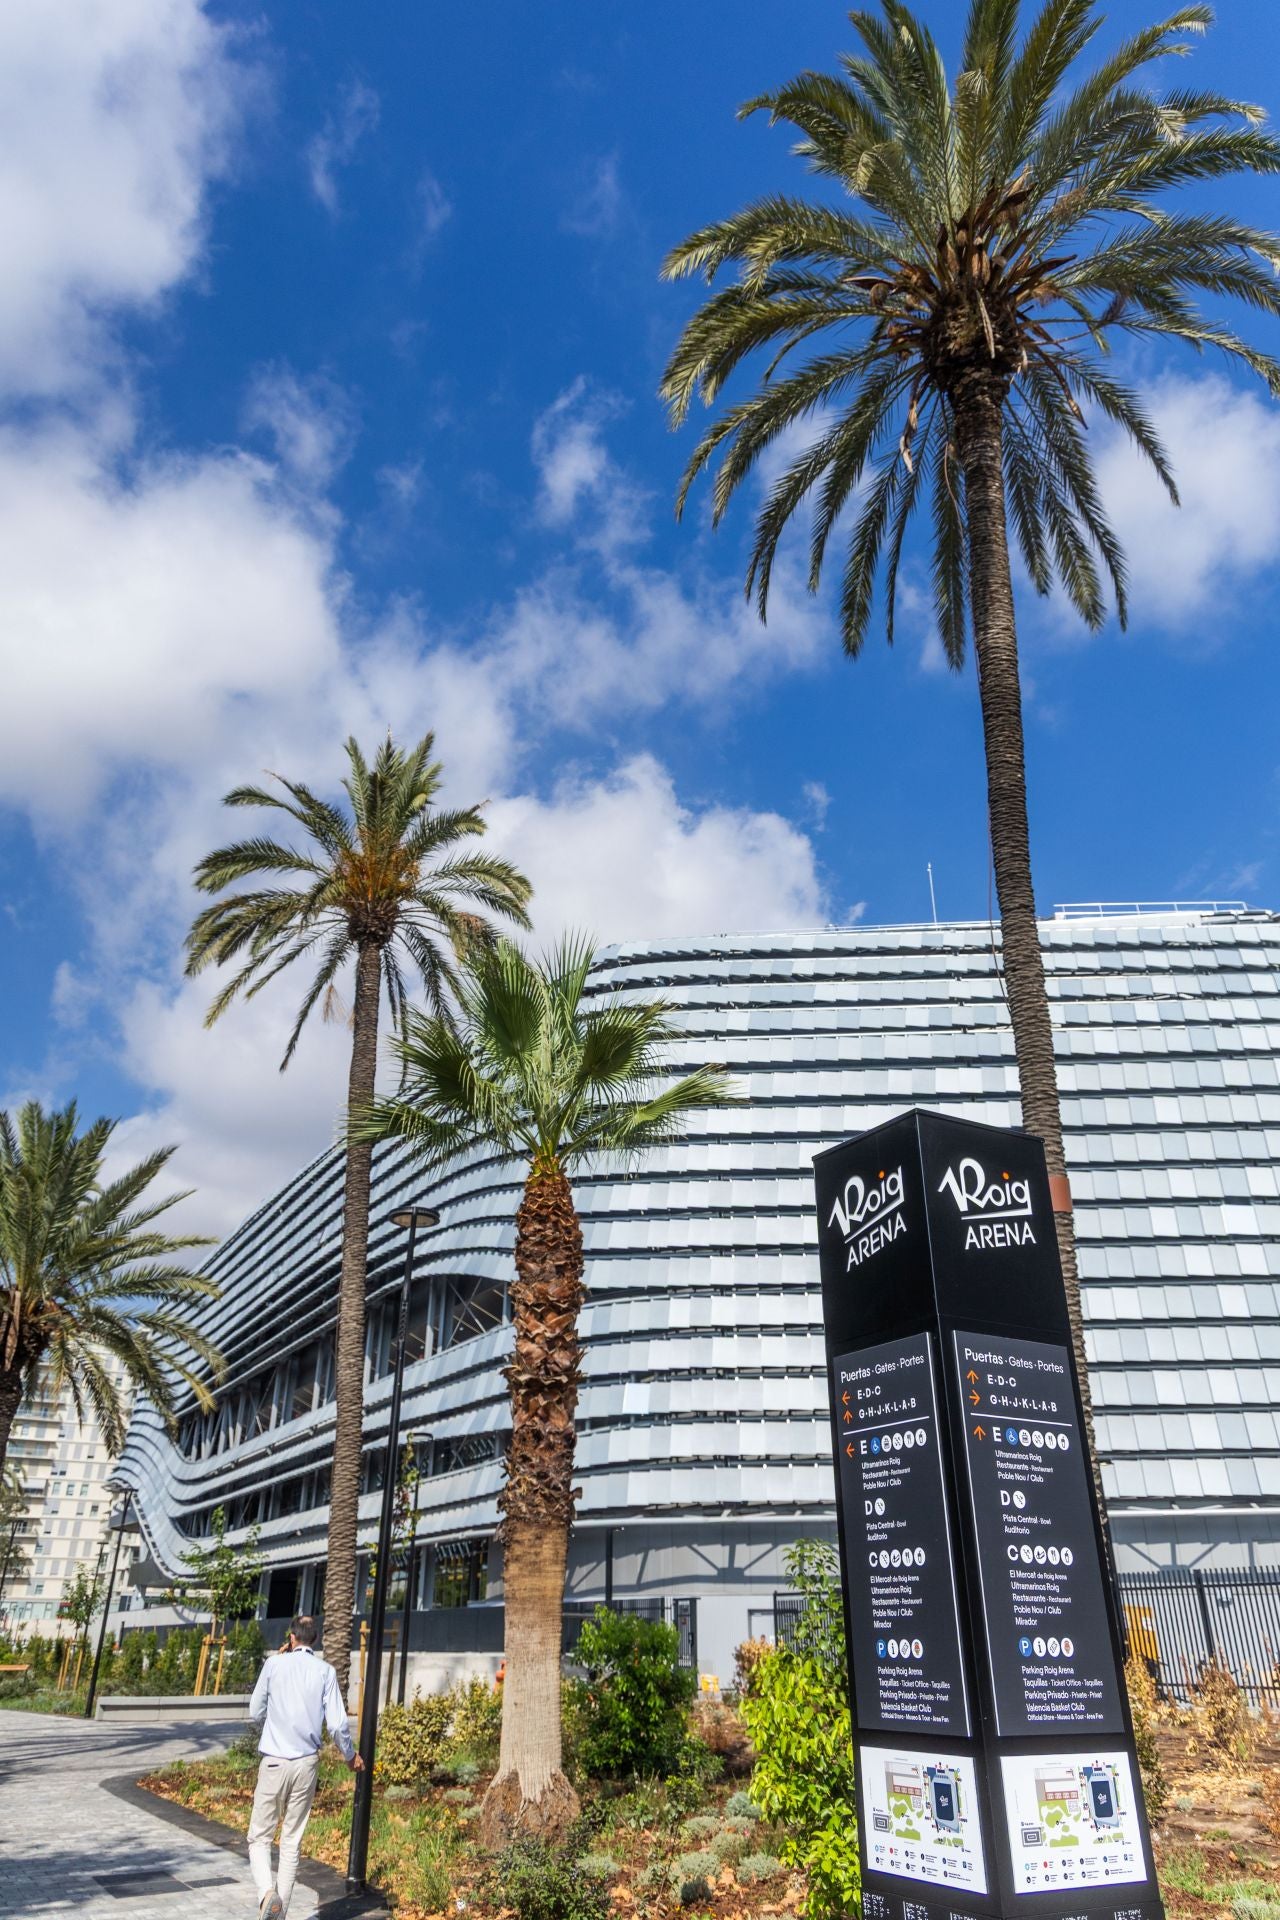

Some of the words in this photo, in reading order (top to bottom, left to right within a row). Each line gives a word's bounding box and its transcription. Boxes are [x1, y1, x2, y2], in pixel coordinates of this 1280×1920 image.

[938, 1157, 1033, 1219] Roig
[828, 1165, 905, 1243] Roig
[965, 1221, 1037, 1250] ARENA
[847, 1211, 907, 1272] ARENA
[964, 1347, 1004, 1365] Puertas
[1008, 1356, 1034, 1369] Gates
[1037, 1360, 1064, 1374] Portes
[841, 1367, 871, 1383] Puertas
[875, 1362, 896, 1374] Gates
[899, 1355, 924, 1369] Portes
[992, 1426, 1002, 1442] E
[860, 1439, 868, 1455] E
[889, 1457, 900, 1466] Roig
[1029, 1453, 1042, 1463] Roig
[890, 1478, 902, 1486] Club
[1030, 1474, 1044, 1482] Club
[1000, 1490, 1010, 1506] D
[864, 1500, 873, 1516] D
[1003, 1514, 1017, 1522] Pista
[1017, 1514, 1038, 1524] Central
[878, 1520, 895, 1530] Central
[1004, 1525, 1030, 1535] Auditorio
[867, 1532, 888, 1541] Auditorio
[1007, 1544, 1019, 1561] C
[868, 1552, 878, 1568] C
[875, 1575, 892, 1583] Mercat
[1009, 1569, 1016, 1578] El
[1016, 1570, 1036, 1579] Mercat
[1044, 1572, 1054, 1581] Roig
[900, 1585, 912, 1594] Roig
[1010, 1581, 1046, 1591] Ultramarinos
[1046, 1582, 1060, 1593] Roig
[1012, 1593, 1046, 1602] Restaurante
[900, 1608, 913, 1616] Club
[1014, 1605, 1031, 1614] Poble
[1031, 1605, 1044, 1614] Nou
[1047, 1606, 1062, 1614] Club
[1015, 1617, 1038, 1626] Mirador
[878, 1666, 896, 1676] Parking
[896, 1667, 908, 1676] Roig
[908, 1667, 923, 1676] Arena
[1021, 1666, 1044, 1676] Parking
[1044, 1666, 1058, 1676] Roig
[1058, 1666, 1074, 1674] Arena
[879, 1678, 899, 1688] Taquillas
[1023, 1678, 1048, 1689] Taquillas
[1051, 1679, 1066, 1687] Ticket
[1066, 1679, 1081, 1687] Office
[880, 1690, 898, 1700] Parking
[898, 1690, 917, 1700] Privado
[1024, 1690, 1047, 1701] Parking
[1047, 1690, 1069, 1699] Privado
[880, 1701, 900, 1711] Valencia
[901, 1702, 918, 1712] Basket
[918, 1703, 932, 1712] Club
[1026, 1703, 1051, 1712] Valencia
[1051, 1702, 1071, 1712] Basket
[1071, 1702, 1085, 1711] Club
